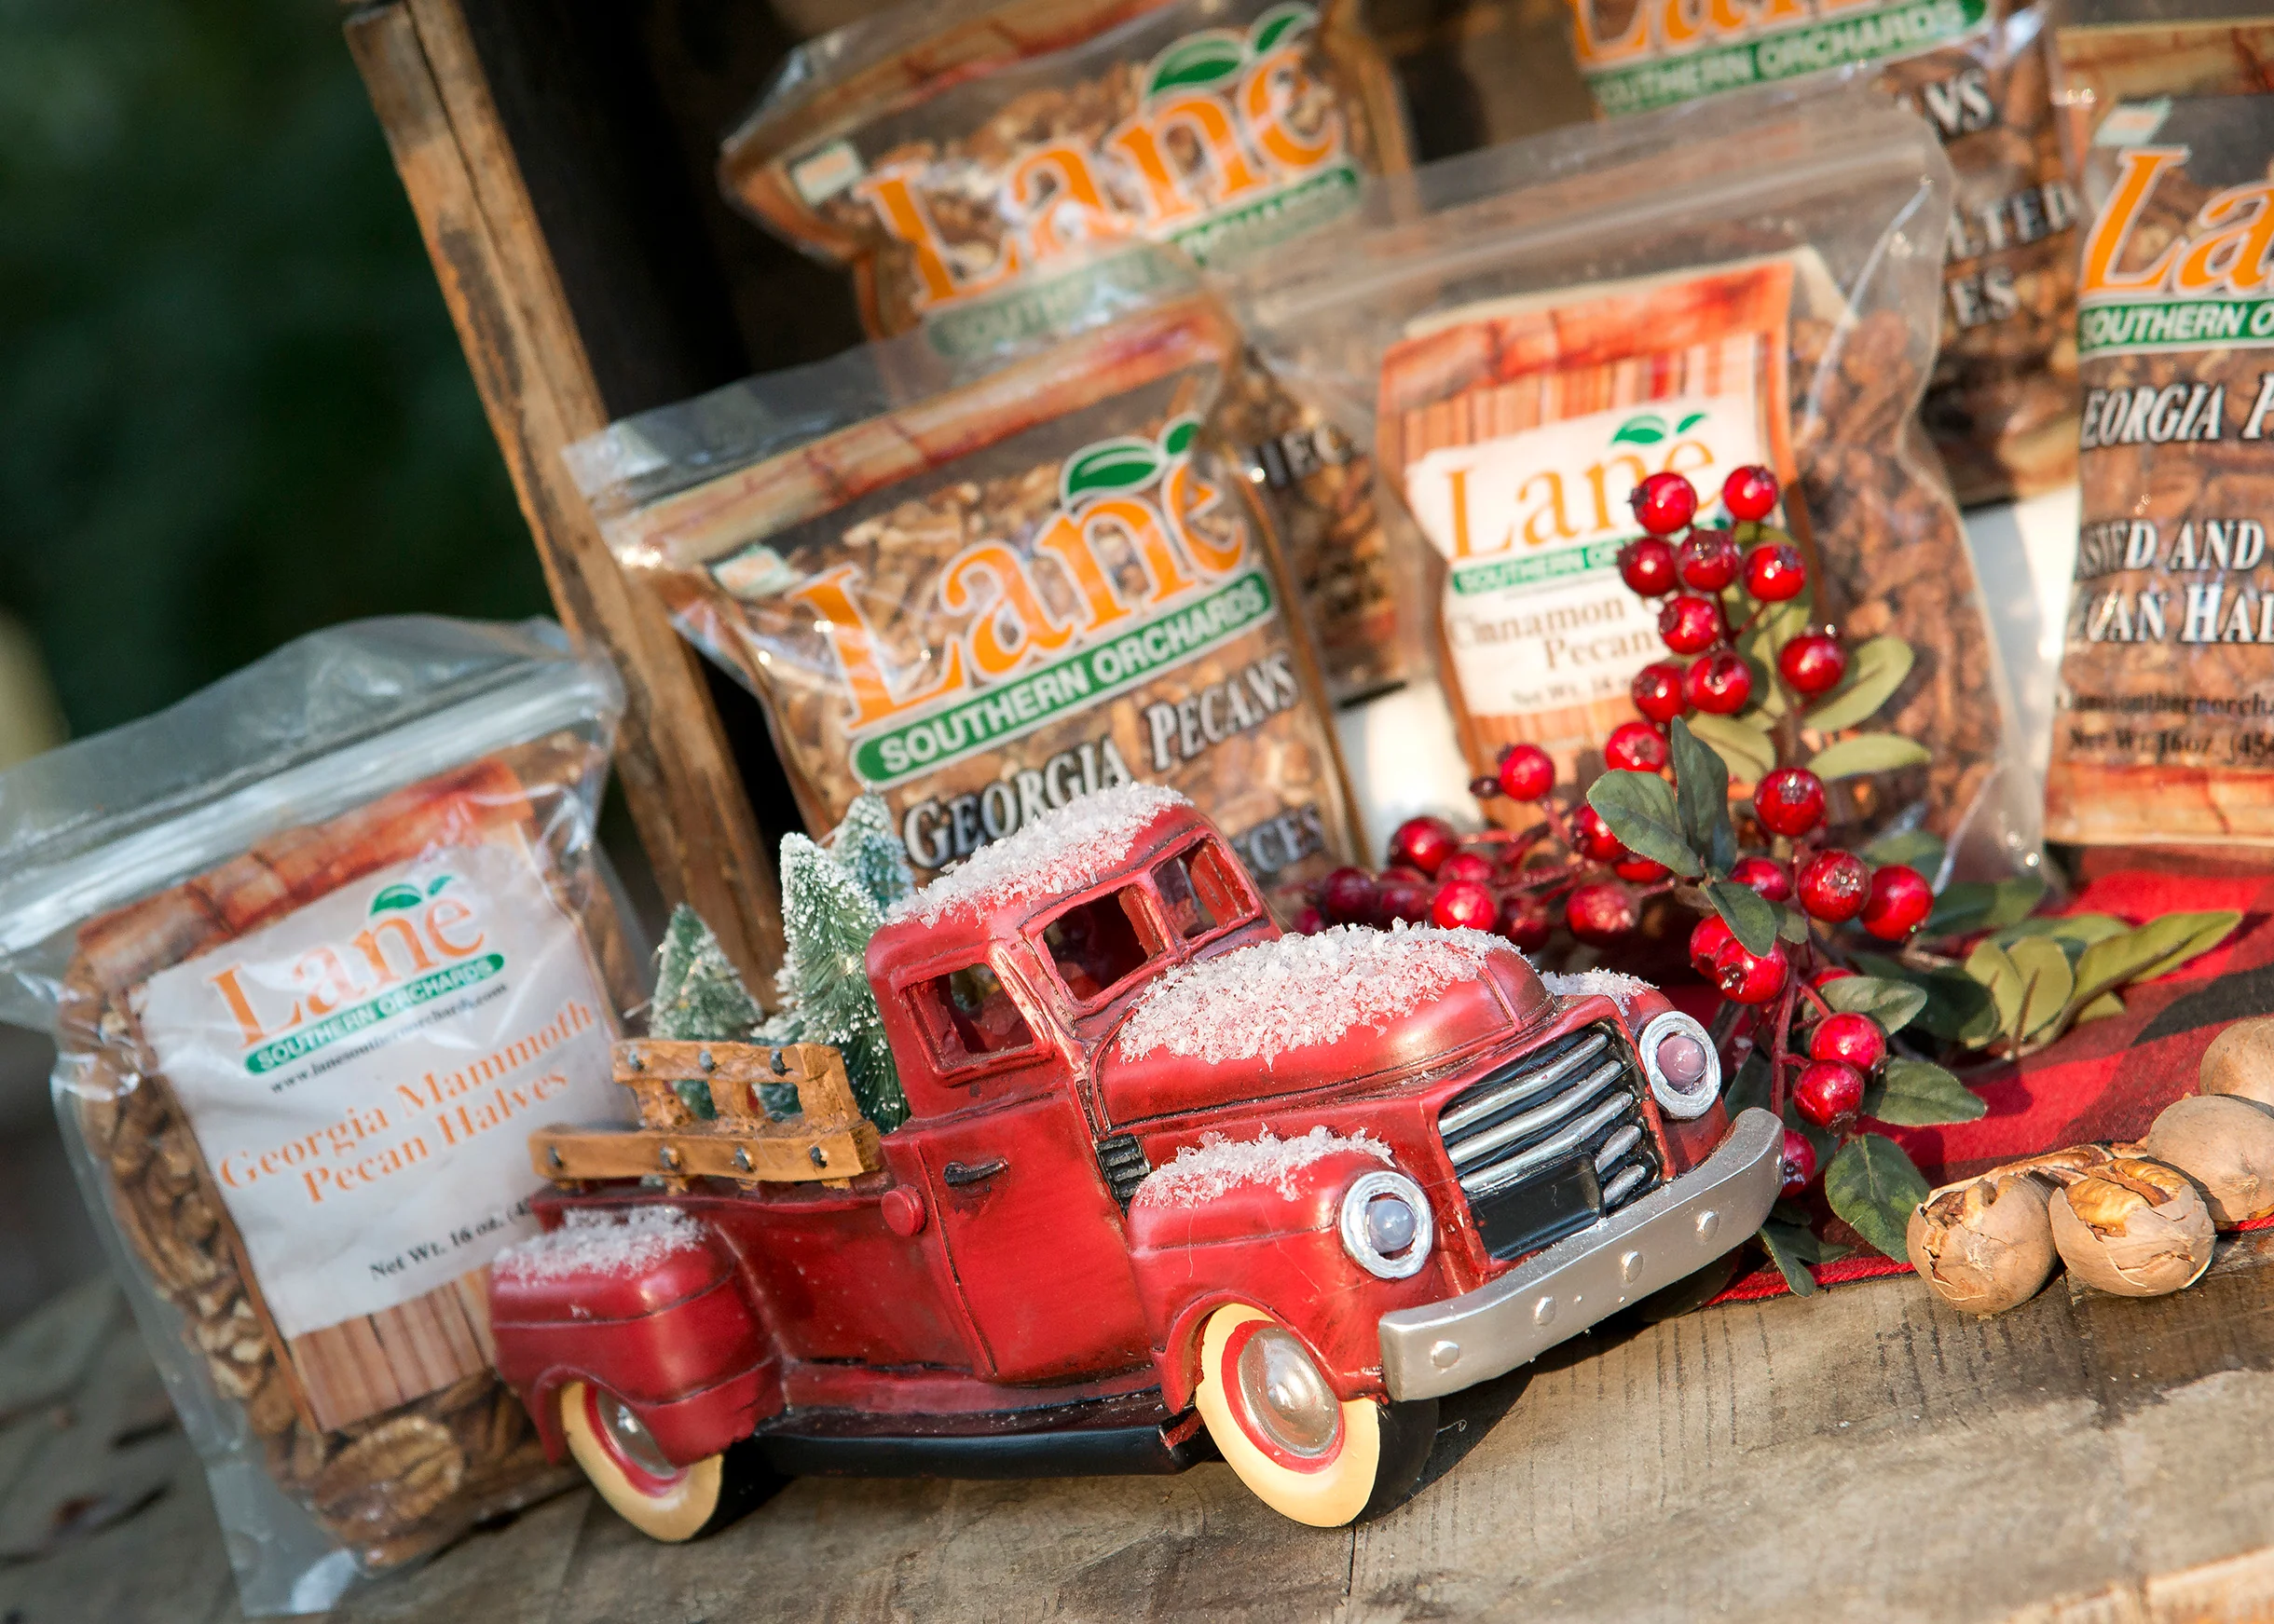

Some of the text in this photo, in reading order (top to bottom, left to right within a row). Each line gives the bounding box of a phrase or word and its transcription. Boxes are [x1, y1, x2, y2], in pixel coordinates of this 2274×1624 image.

[856, 45, 1342, 307] Lane
[2080, 147, 2274, 296] La
[2081, 380, 2225, 449] EORGIA
[1443, 440, 1720, 561] Lane
[2168, 519, 2267, 571] AND
[788, 457, 1249, 730] Lane
[2176, 581, 2274, 645] HAL
[879, 579, 1266, 774] SOUTHERN ORCHARDS
[902, 654, 1299, 869] GEORGIA PECANS
[212, 897, 486, 1051] Lane
[257, 958, 496, 1071] SOUTHERN ORCHARDS
[219, 999, 595, 1191] Georgia Mammoth
[302, 1065, 569, 1204] Pecan Halves
[370, 1255, 406, 1278] Net
[408, 1241, 447, 1263] Wt.
[450, 1226, 474, 1249] 16
